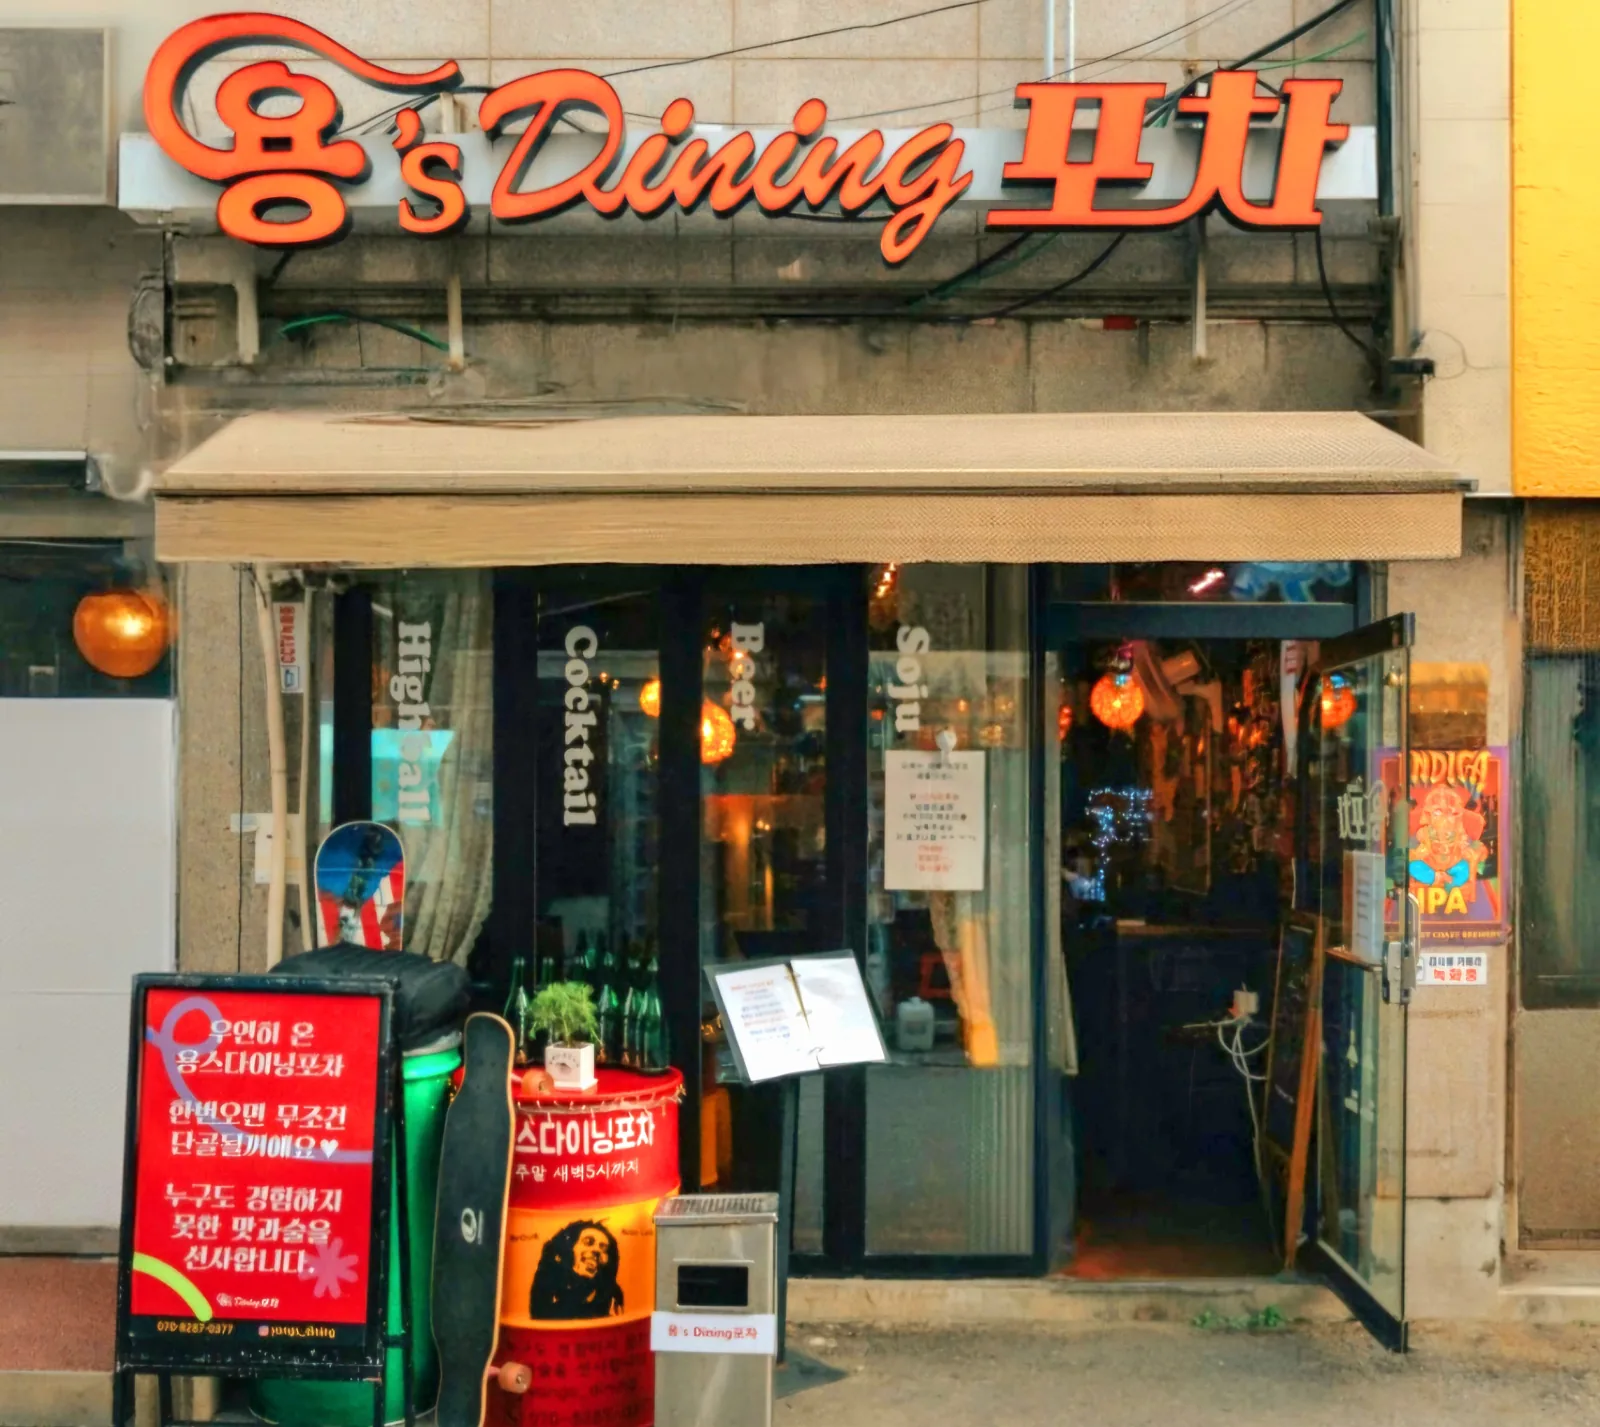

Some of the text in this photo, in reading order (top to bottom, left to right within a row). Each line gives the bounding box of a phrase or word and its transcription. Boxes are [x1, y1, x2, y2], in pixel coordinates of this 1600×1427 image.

[479, 68, 975, 265] Dining
[985, 68, 1350, 229] 포차
[730, 620, 764, 730] Beer
[887, 625, 931, 733] Soju
[563, 625, 598, 827] Cocktail
[1417, 887, 1468, 915] IPA
[176, 1049, 345, 1078] 용스다이닝포차
[275, 1104, 347, 1131] 무조건
[164, 1182, 342, 1213] 누구도 경험하지
[171, 1213, 221, 1240] 못한
